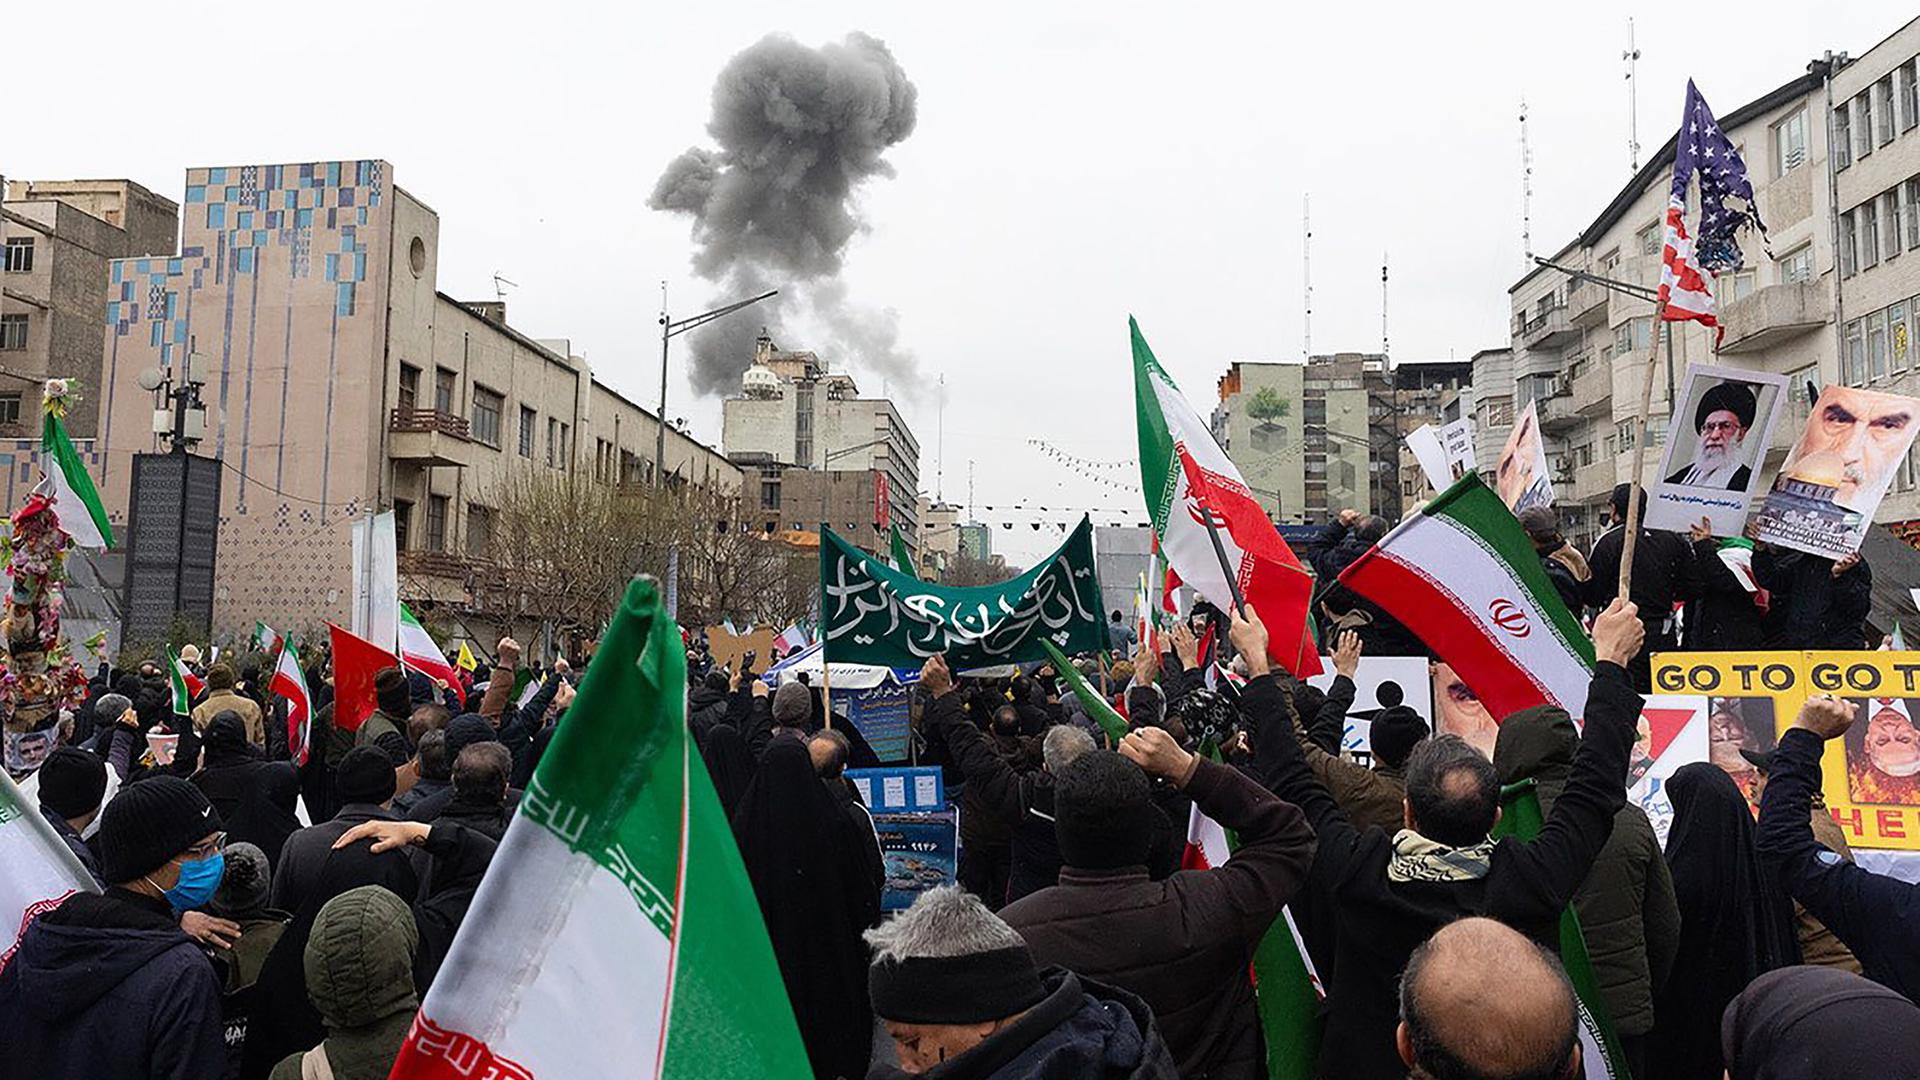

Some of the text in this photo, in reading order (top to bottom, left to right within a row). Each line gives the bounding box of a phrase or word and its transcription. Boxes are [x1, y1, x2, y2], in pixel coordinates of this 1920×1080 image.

[1656, 663, 1796, 691] GO TO
[1811, 663, 1920, 691] GO T
[1830, 807, 1908, 838] HE
